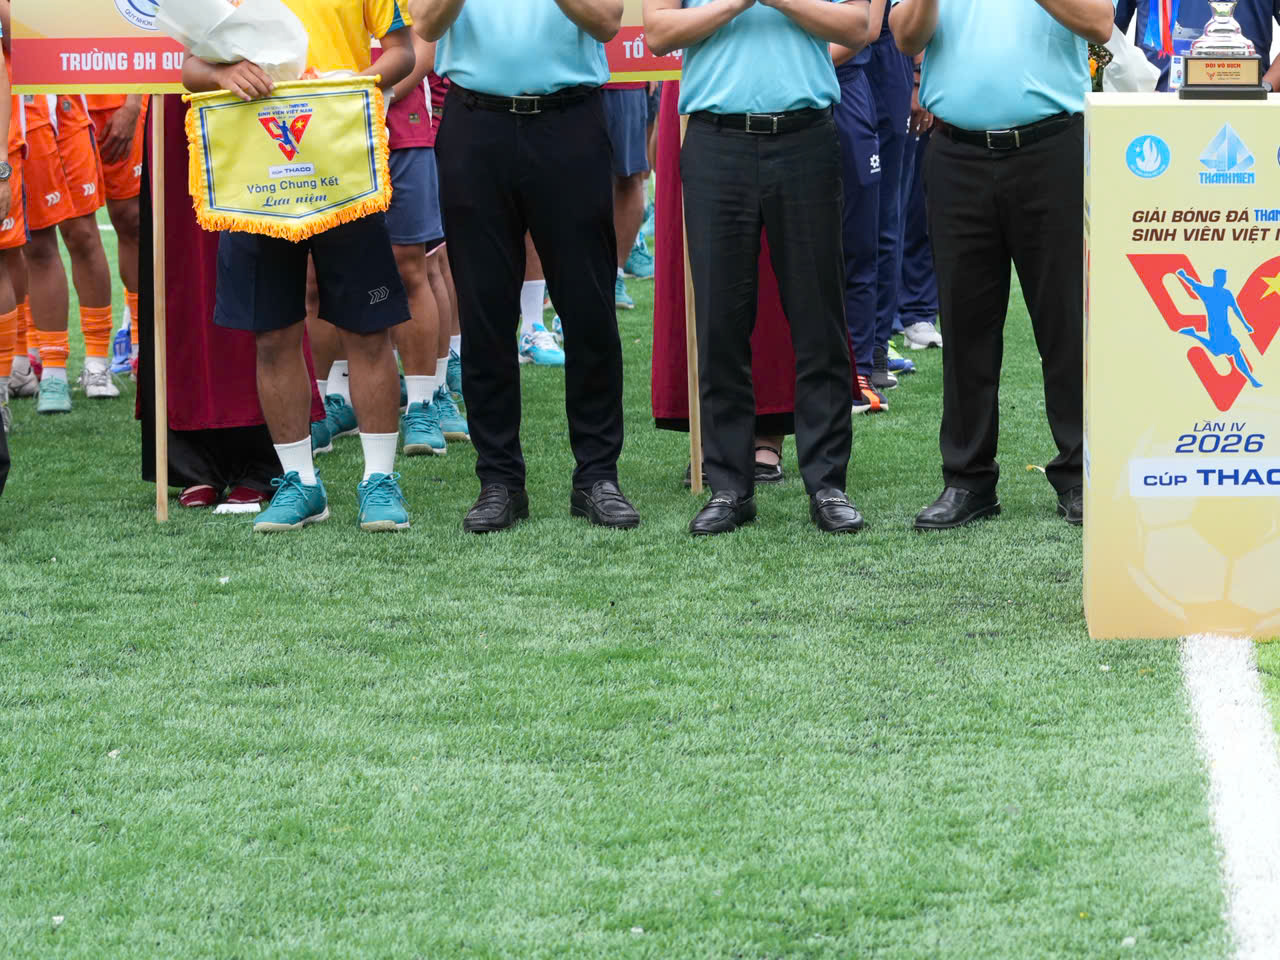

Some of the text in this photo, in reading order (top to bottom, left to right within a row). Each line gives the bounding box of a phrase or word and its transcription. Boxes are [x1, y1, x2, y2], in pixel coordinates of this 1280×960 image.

[623, 34, 644, 59] TỔ
[60, 48, 184, 71] TRƯỜNG ĐH QU
[284, 166, 311, 174] THACO
[1199, 172, 1232, 184] THANH
[247, 176, 339, 195] Vòng Chung Kết
[1132, 206, 1166, 223] GIẢI
[1171, 207, 1221, 223] BÓNG
[1225, 207, 1249, 223] ĐÁ
[1132, 228, 1177, 241] SINH
[1183, 225, 1226, 241] VIÊN
[1232, 225, 1270, 244] VIỆT
[1193, 419, 1246, 432] LẦN IV
[1175, 433, 1265, 454] 2026
[1143, 472, 1188, 486] CÚP
